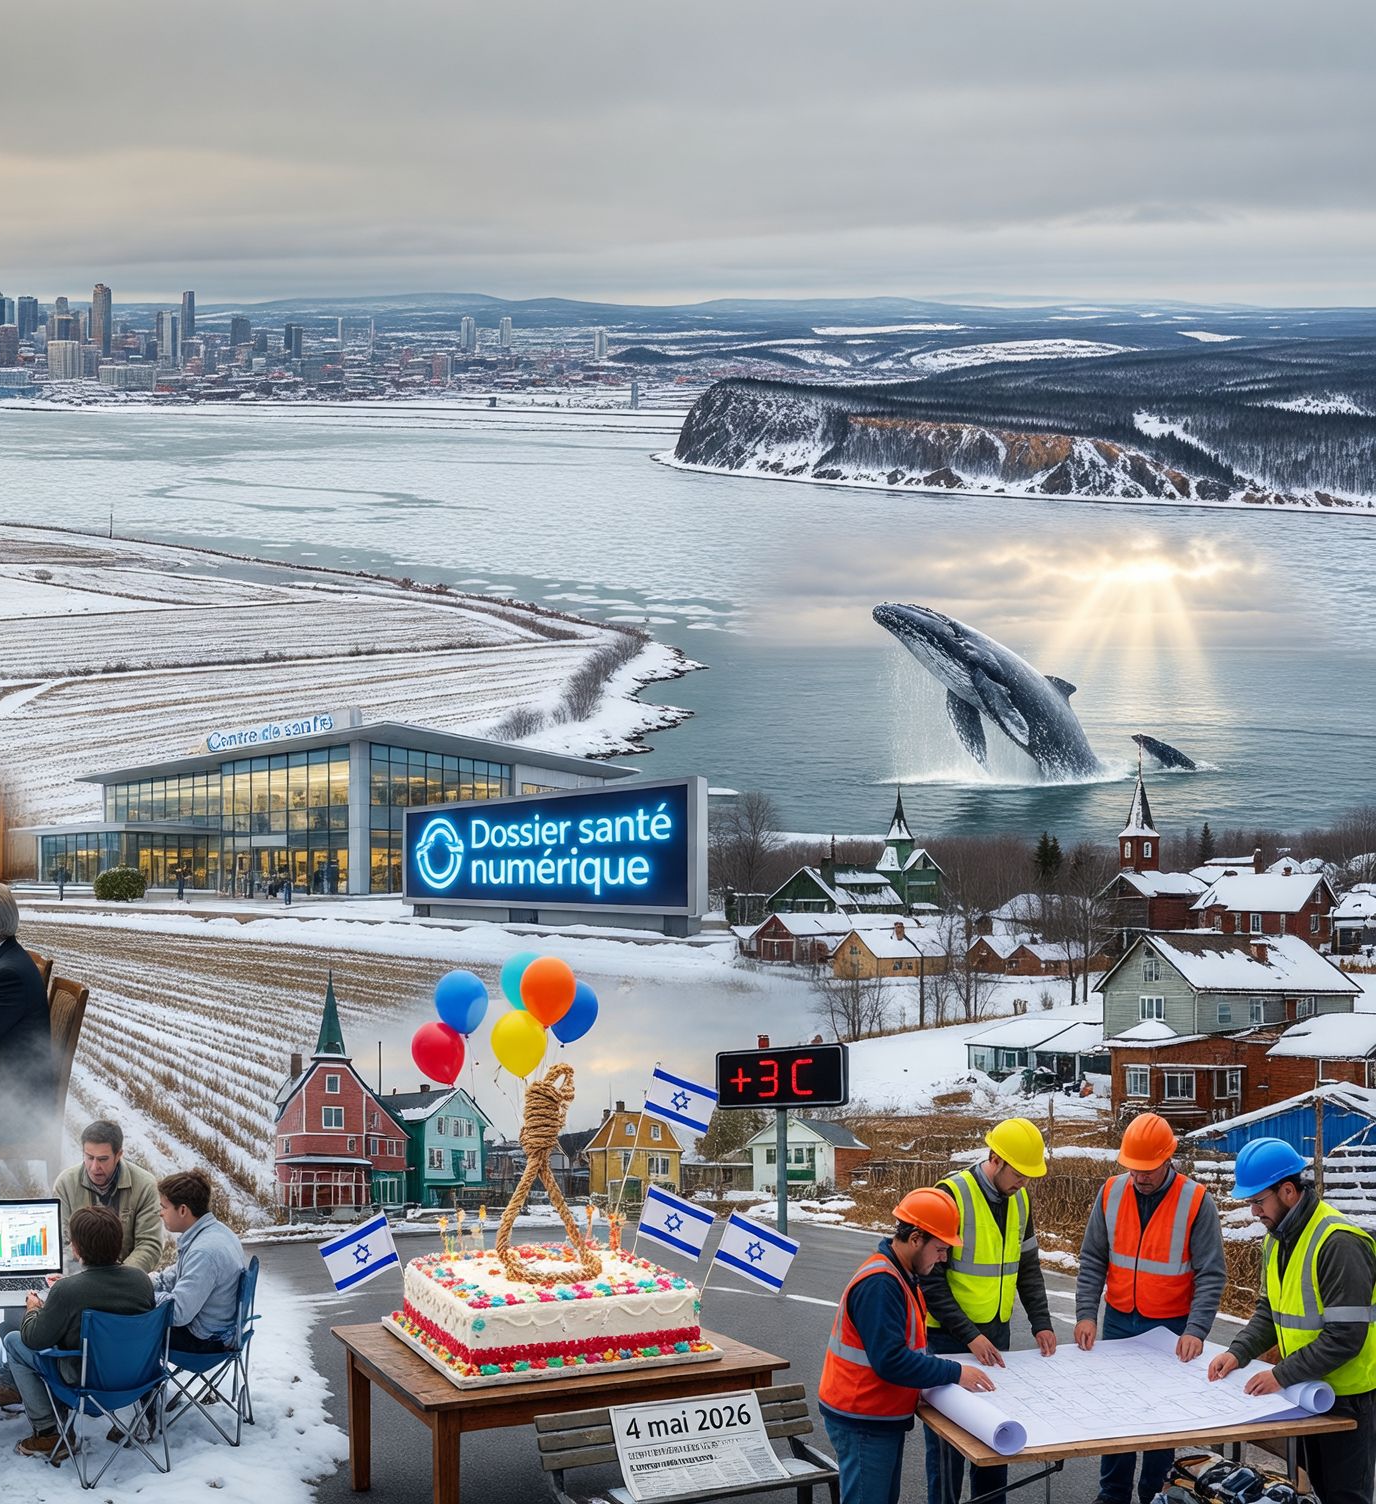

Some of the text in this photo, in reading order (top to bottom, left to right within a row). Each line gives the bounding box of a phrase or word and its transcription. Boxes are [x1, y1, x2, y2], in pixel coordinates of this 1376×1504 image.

[470, 802, 672, 849] Dossier santé
[470, 847, 650, 896] numérique
[626, 1403, 752, 1440] 4 mai 2026
